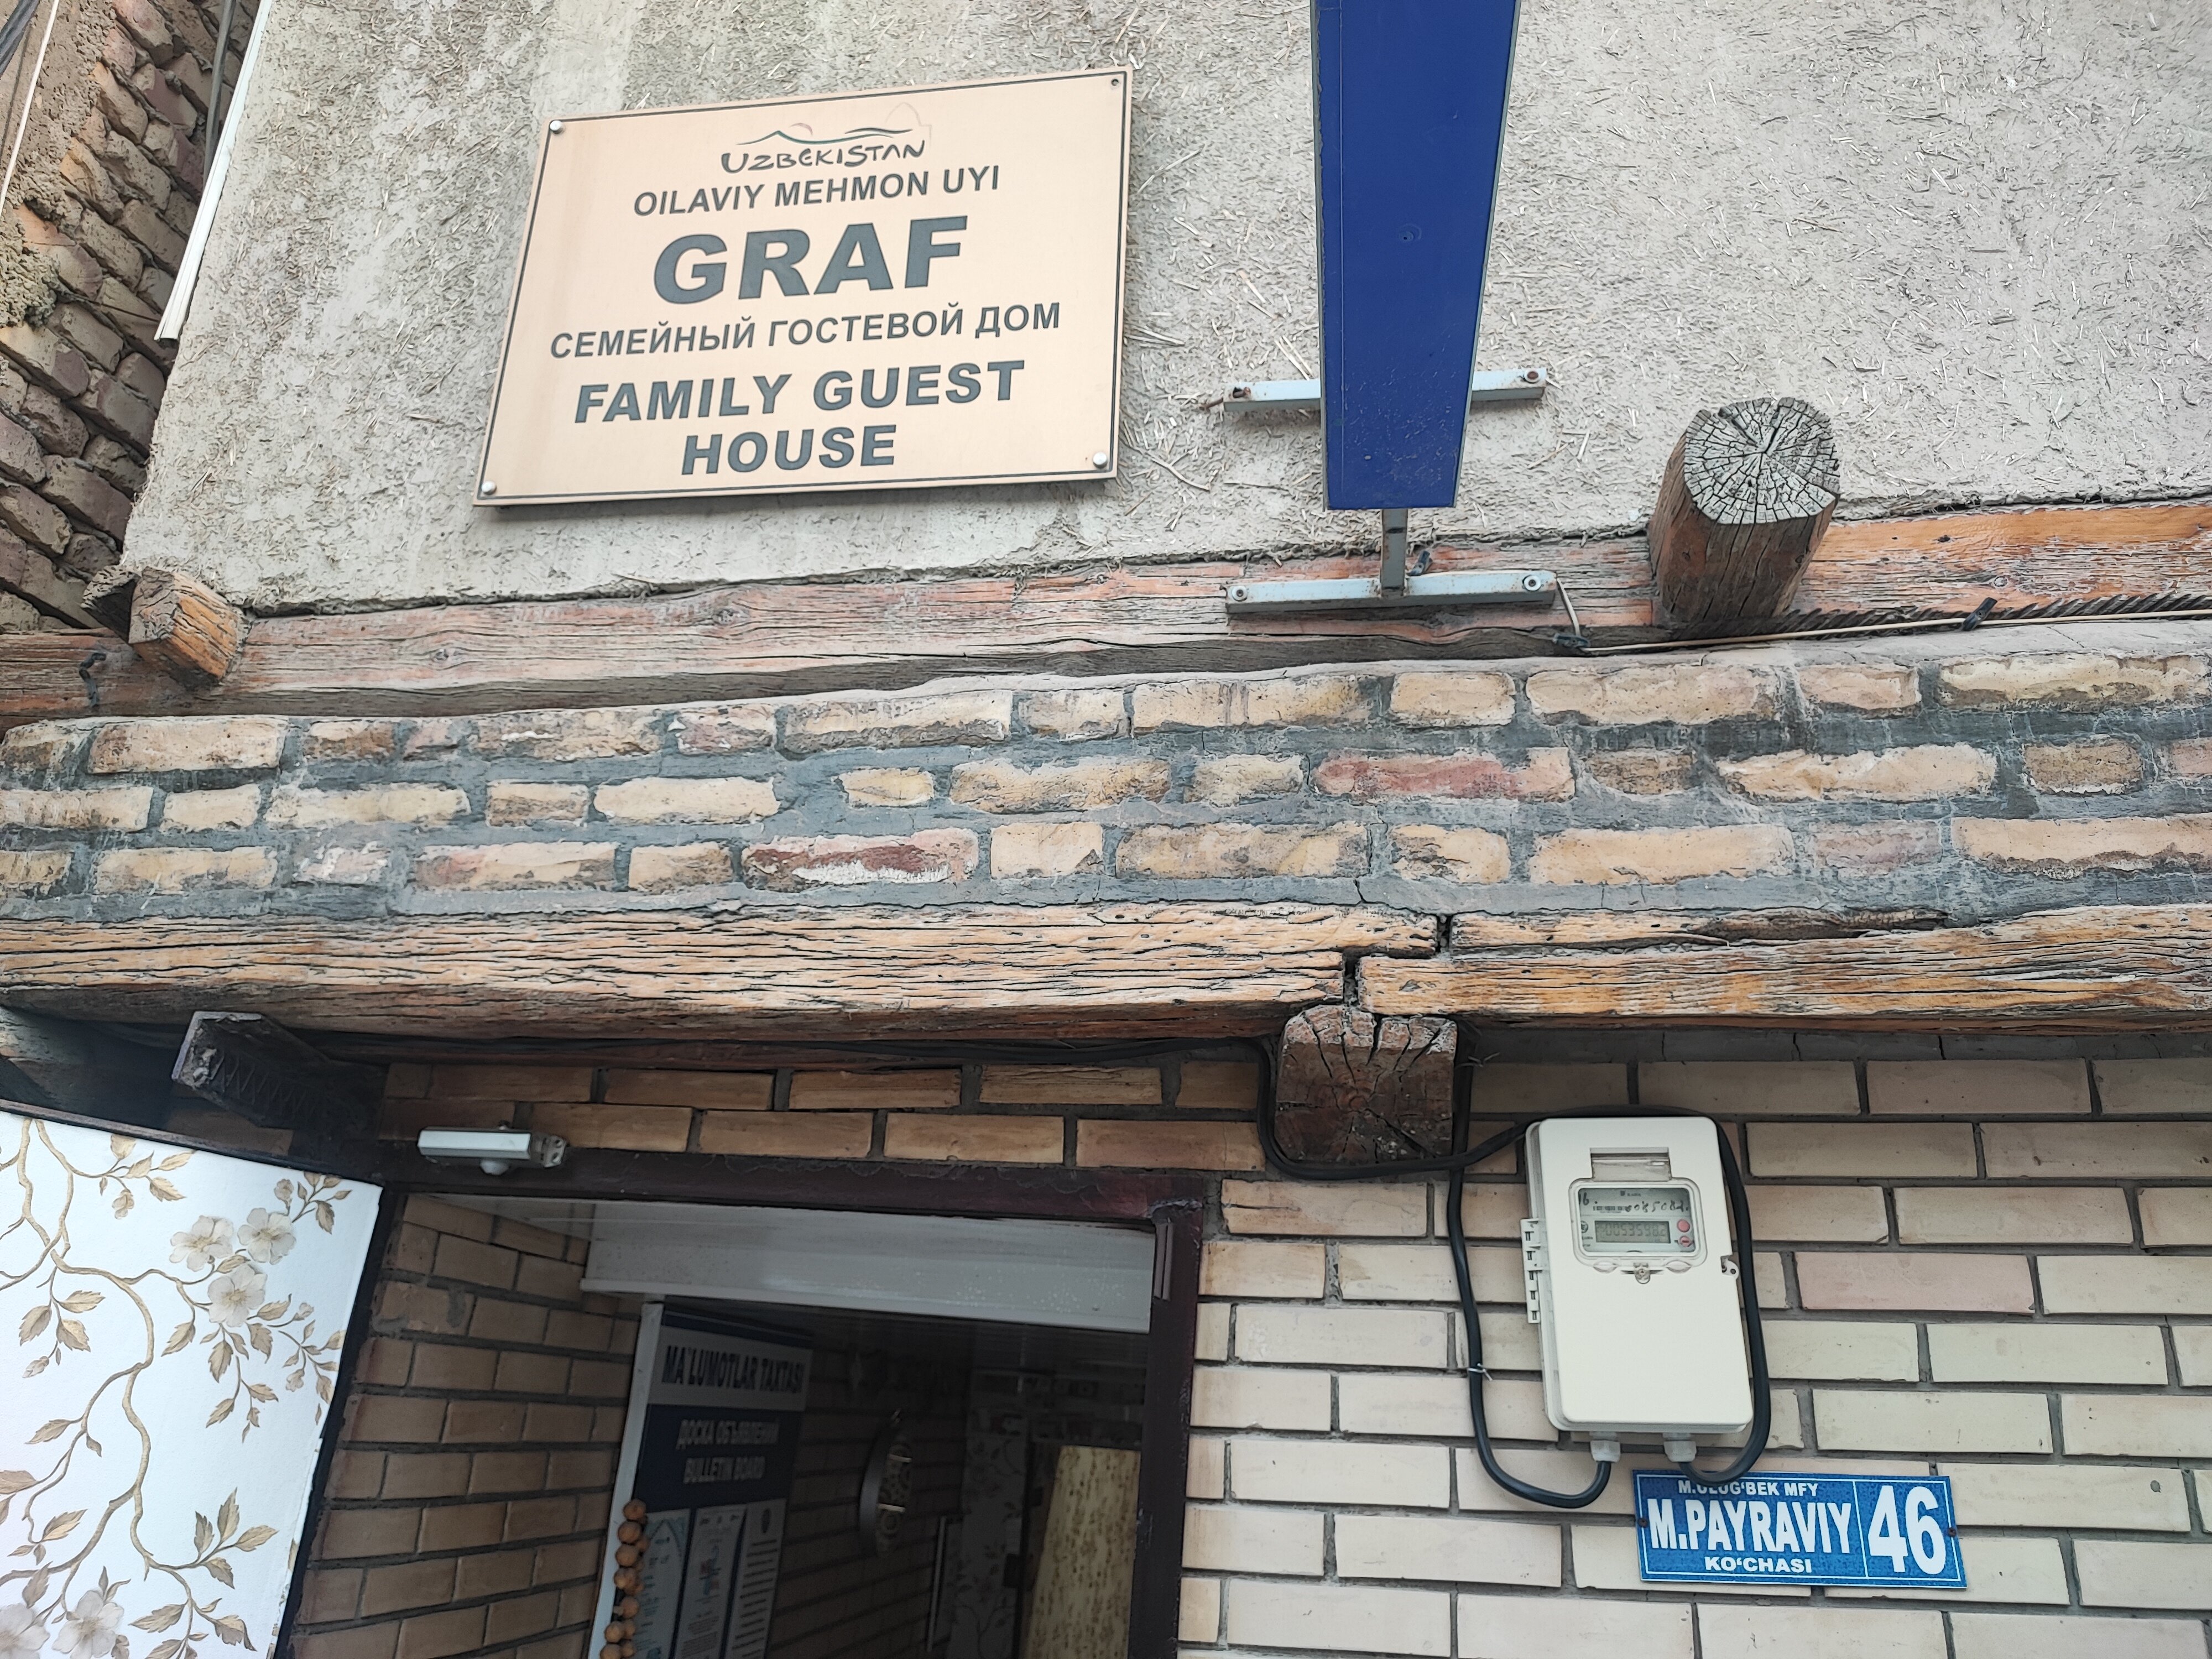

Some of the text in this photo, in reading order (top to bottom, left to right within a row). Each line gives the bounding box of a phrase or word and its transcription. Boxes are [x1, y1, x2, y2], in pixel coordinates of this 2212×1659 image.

[721, 140, 926, 174] UZBEKISTAN
[634, 165, 999, 216] OILAVIY MEHMON UYI
[654, 215, 968, 305] GRAF
[550, 302, 1060, 358] СЕМЕЙНЫЙ ГОСТЕВОЙ ДОМ
[575, 360, 1025, 424] FAMILY GUEST
[681, 424, 897, 476] HOUSE
[1784, 1482, 1819, 1497] MFY
[1647, 1484, 1947, 1575] M.PAYRAVIY 46
